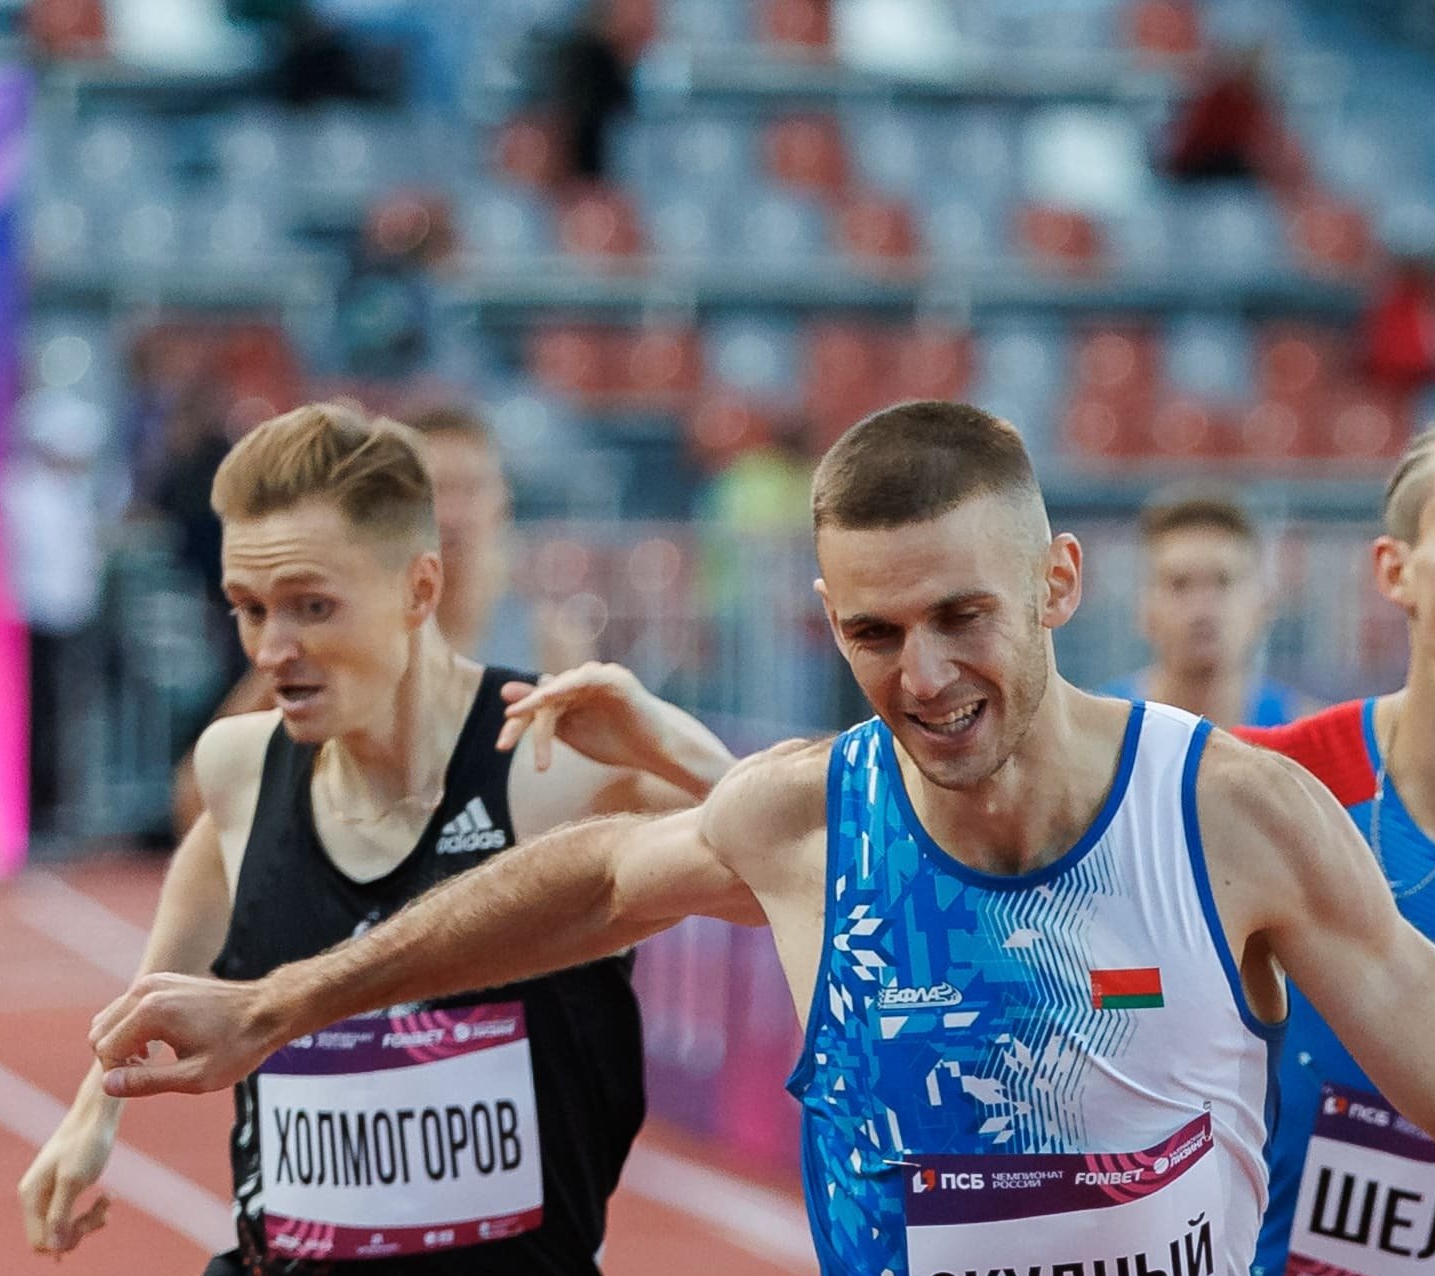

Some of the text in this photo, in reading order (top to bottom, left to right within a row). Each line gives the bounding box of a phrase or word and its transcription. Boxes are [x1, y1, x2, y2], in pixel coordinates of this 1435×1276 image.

[273, 1099, 522, 1187] ХОЛМОГОРОВ
[941, 1173, 985, 1190] ПСБ
[991, 1170, 1064, 1181] ЧЕМПИОНАТ
[992, 1178, 1042, 1189] РОССИИ
[1075, 1168, 1145, 1185] FONBET
